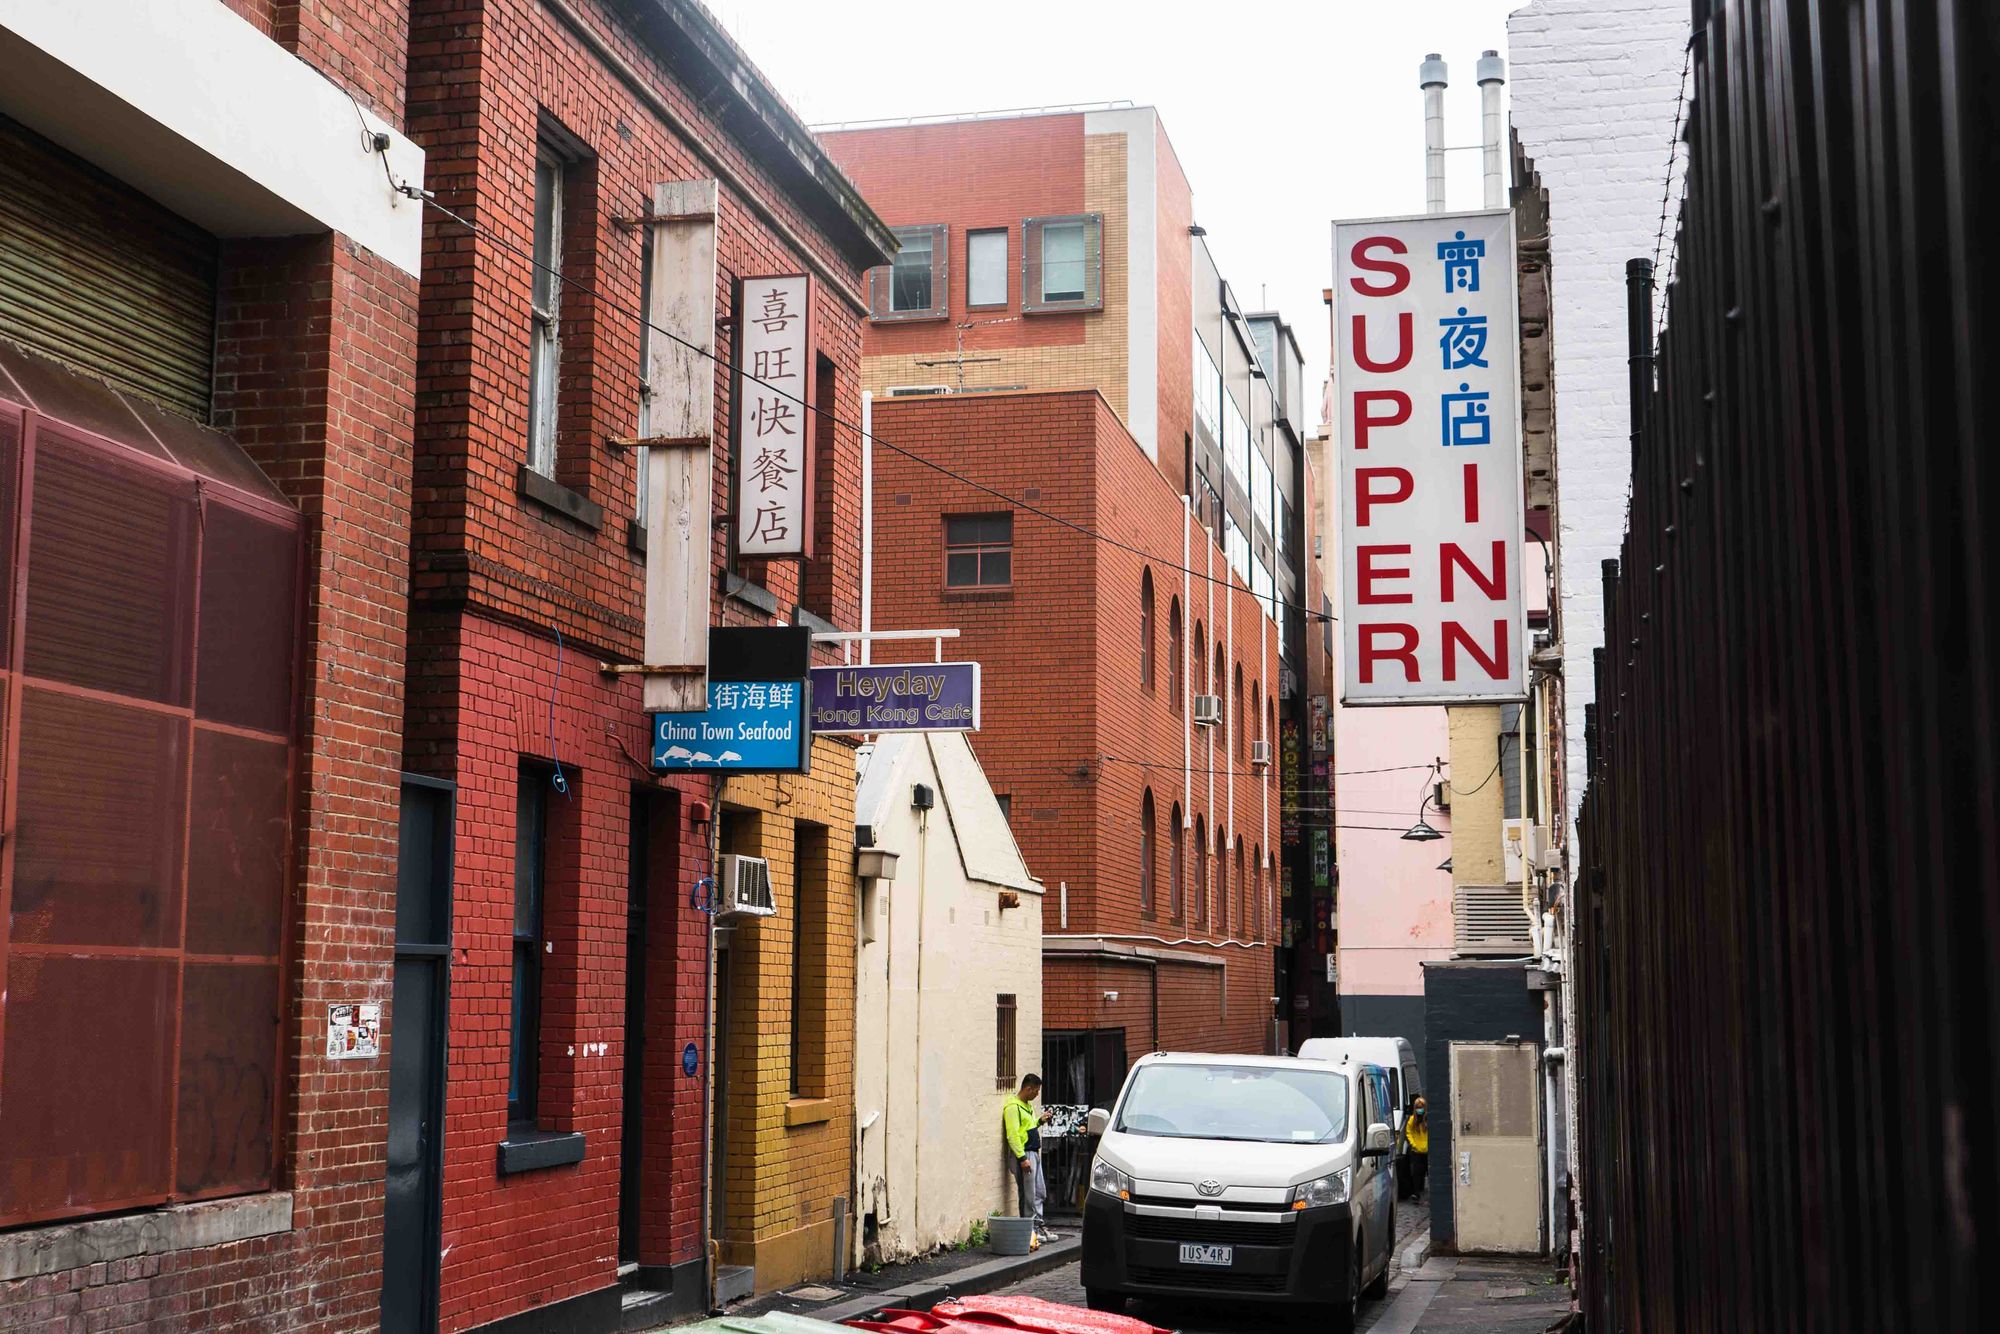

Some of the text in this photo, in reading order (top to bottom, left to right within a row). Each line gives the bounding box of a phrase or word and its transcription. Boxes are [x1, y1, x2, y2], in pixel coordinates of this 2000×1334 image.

[1437, 230, 1491, 447] 宵夜店
[746, 288, 799, 544] 喜旺快餐店
[1350, 236, 1421, 684] SUPPER
[1440, 463, 1509, 682] INN
[660, 720, 792, 740] China Town Seafood
[706, 683, 793, 711] 街海鲜
[836, 669, 946, 702] Heyday
[867, 705, 919, 724] Kong
[925, 703, 973, 720] Cafe
